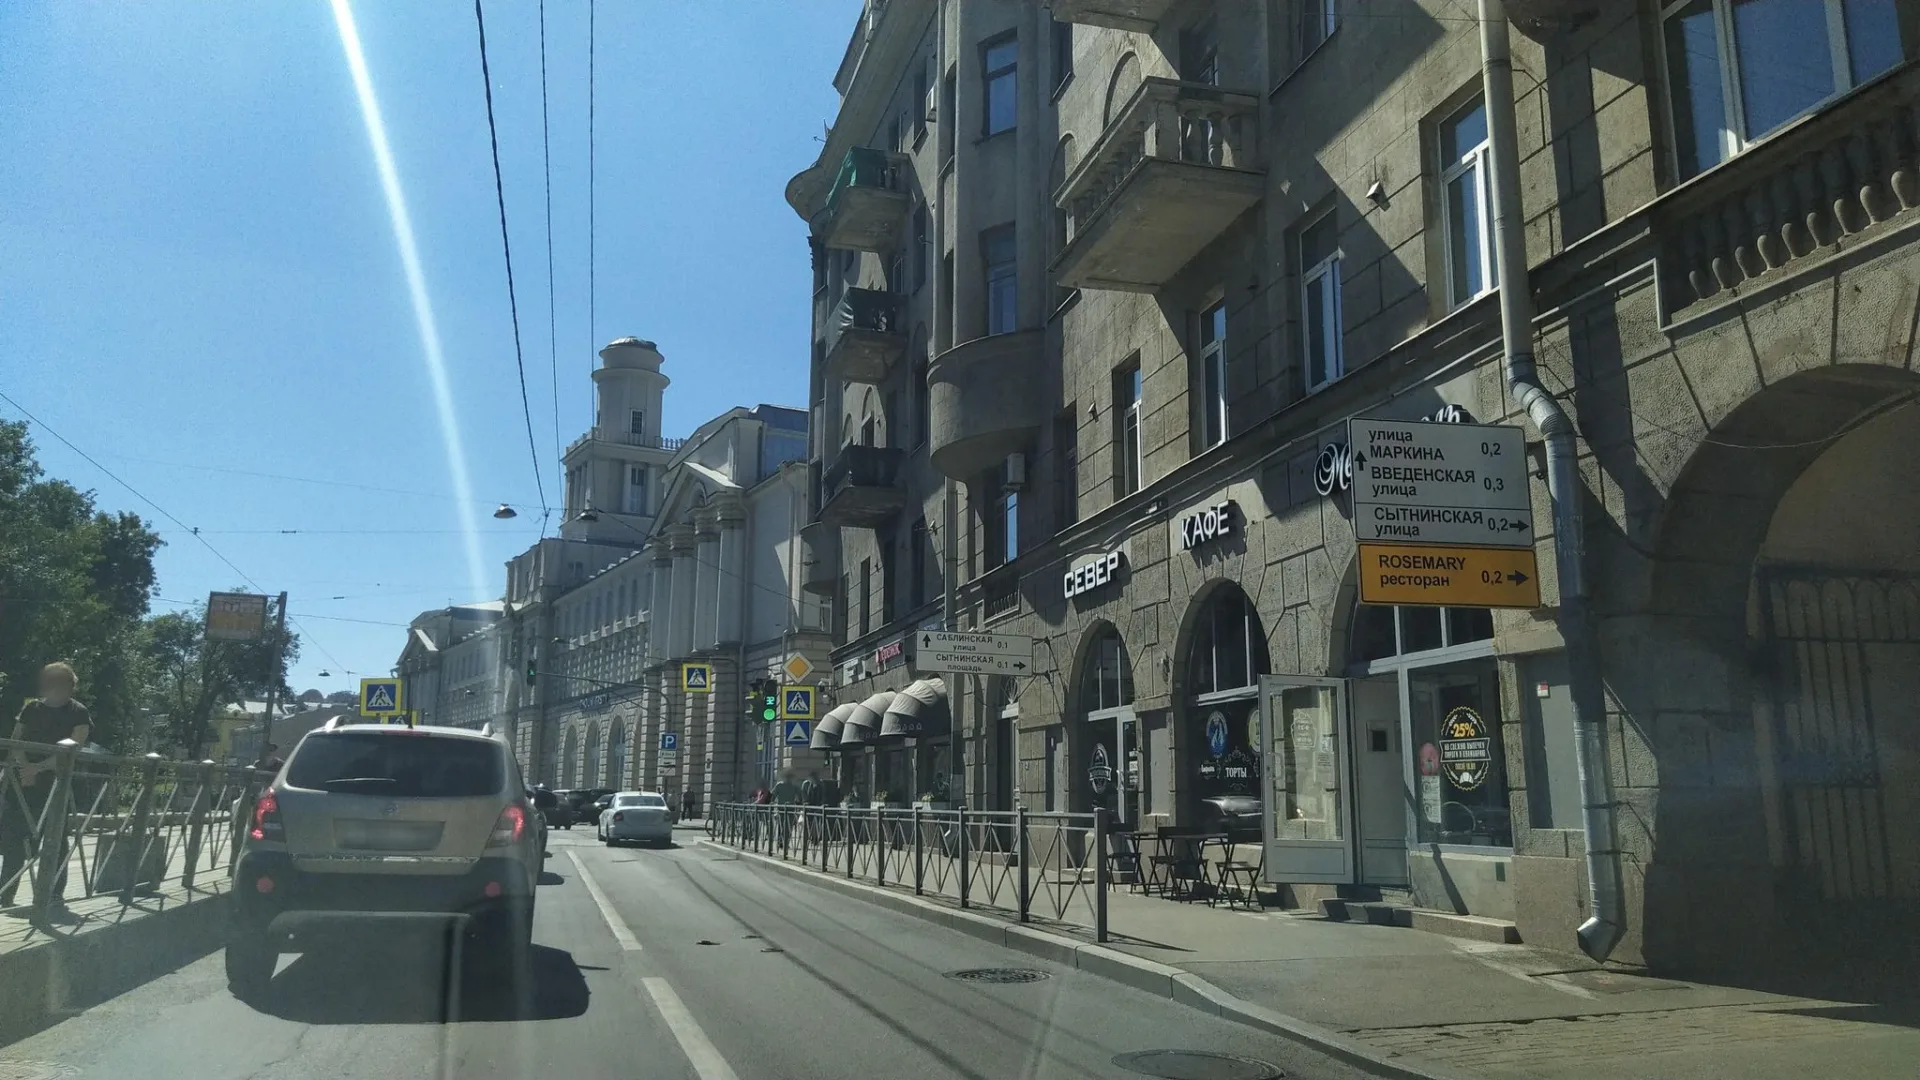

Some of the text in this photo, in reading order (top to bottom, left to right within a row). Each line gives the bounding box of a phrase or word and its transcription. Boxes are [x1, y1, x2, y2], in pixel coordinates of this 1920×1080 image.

[1368, 430, 1413, 443] улица
[1370, 442, 1501, 461] МАРКИНА 0,2
[1371, 466, 1504, 492] ВВЕДЕНСКАЯ 0,3
[1372, 485, 1417, 498] улица
[1181, 501, 1229, 550] КАФЕ
[1374, 507, 1509, 533] СЫТНИНСКАЯ 0,2
[1375, 524, 1420, 537] улица
[1379, 555, 1466, 570] ROSEMARY
[1064, 551, 1119, 599] СЕВЕР
[1380, 570, 1502, 589] ресторан 0,2
[936, 633, 993, 643] САБЛИНСКАЯ
[936, 653, 994, 663] СЫТНИНСКАЯ
[947, 664, 982, 672] площадь
[665, 735, 675, 748] P
[1225, 767, 1247, 778] ТОРТЫ
